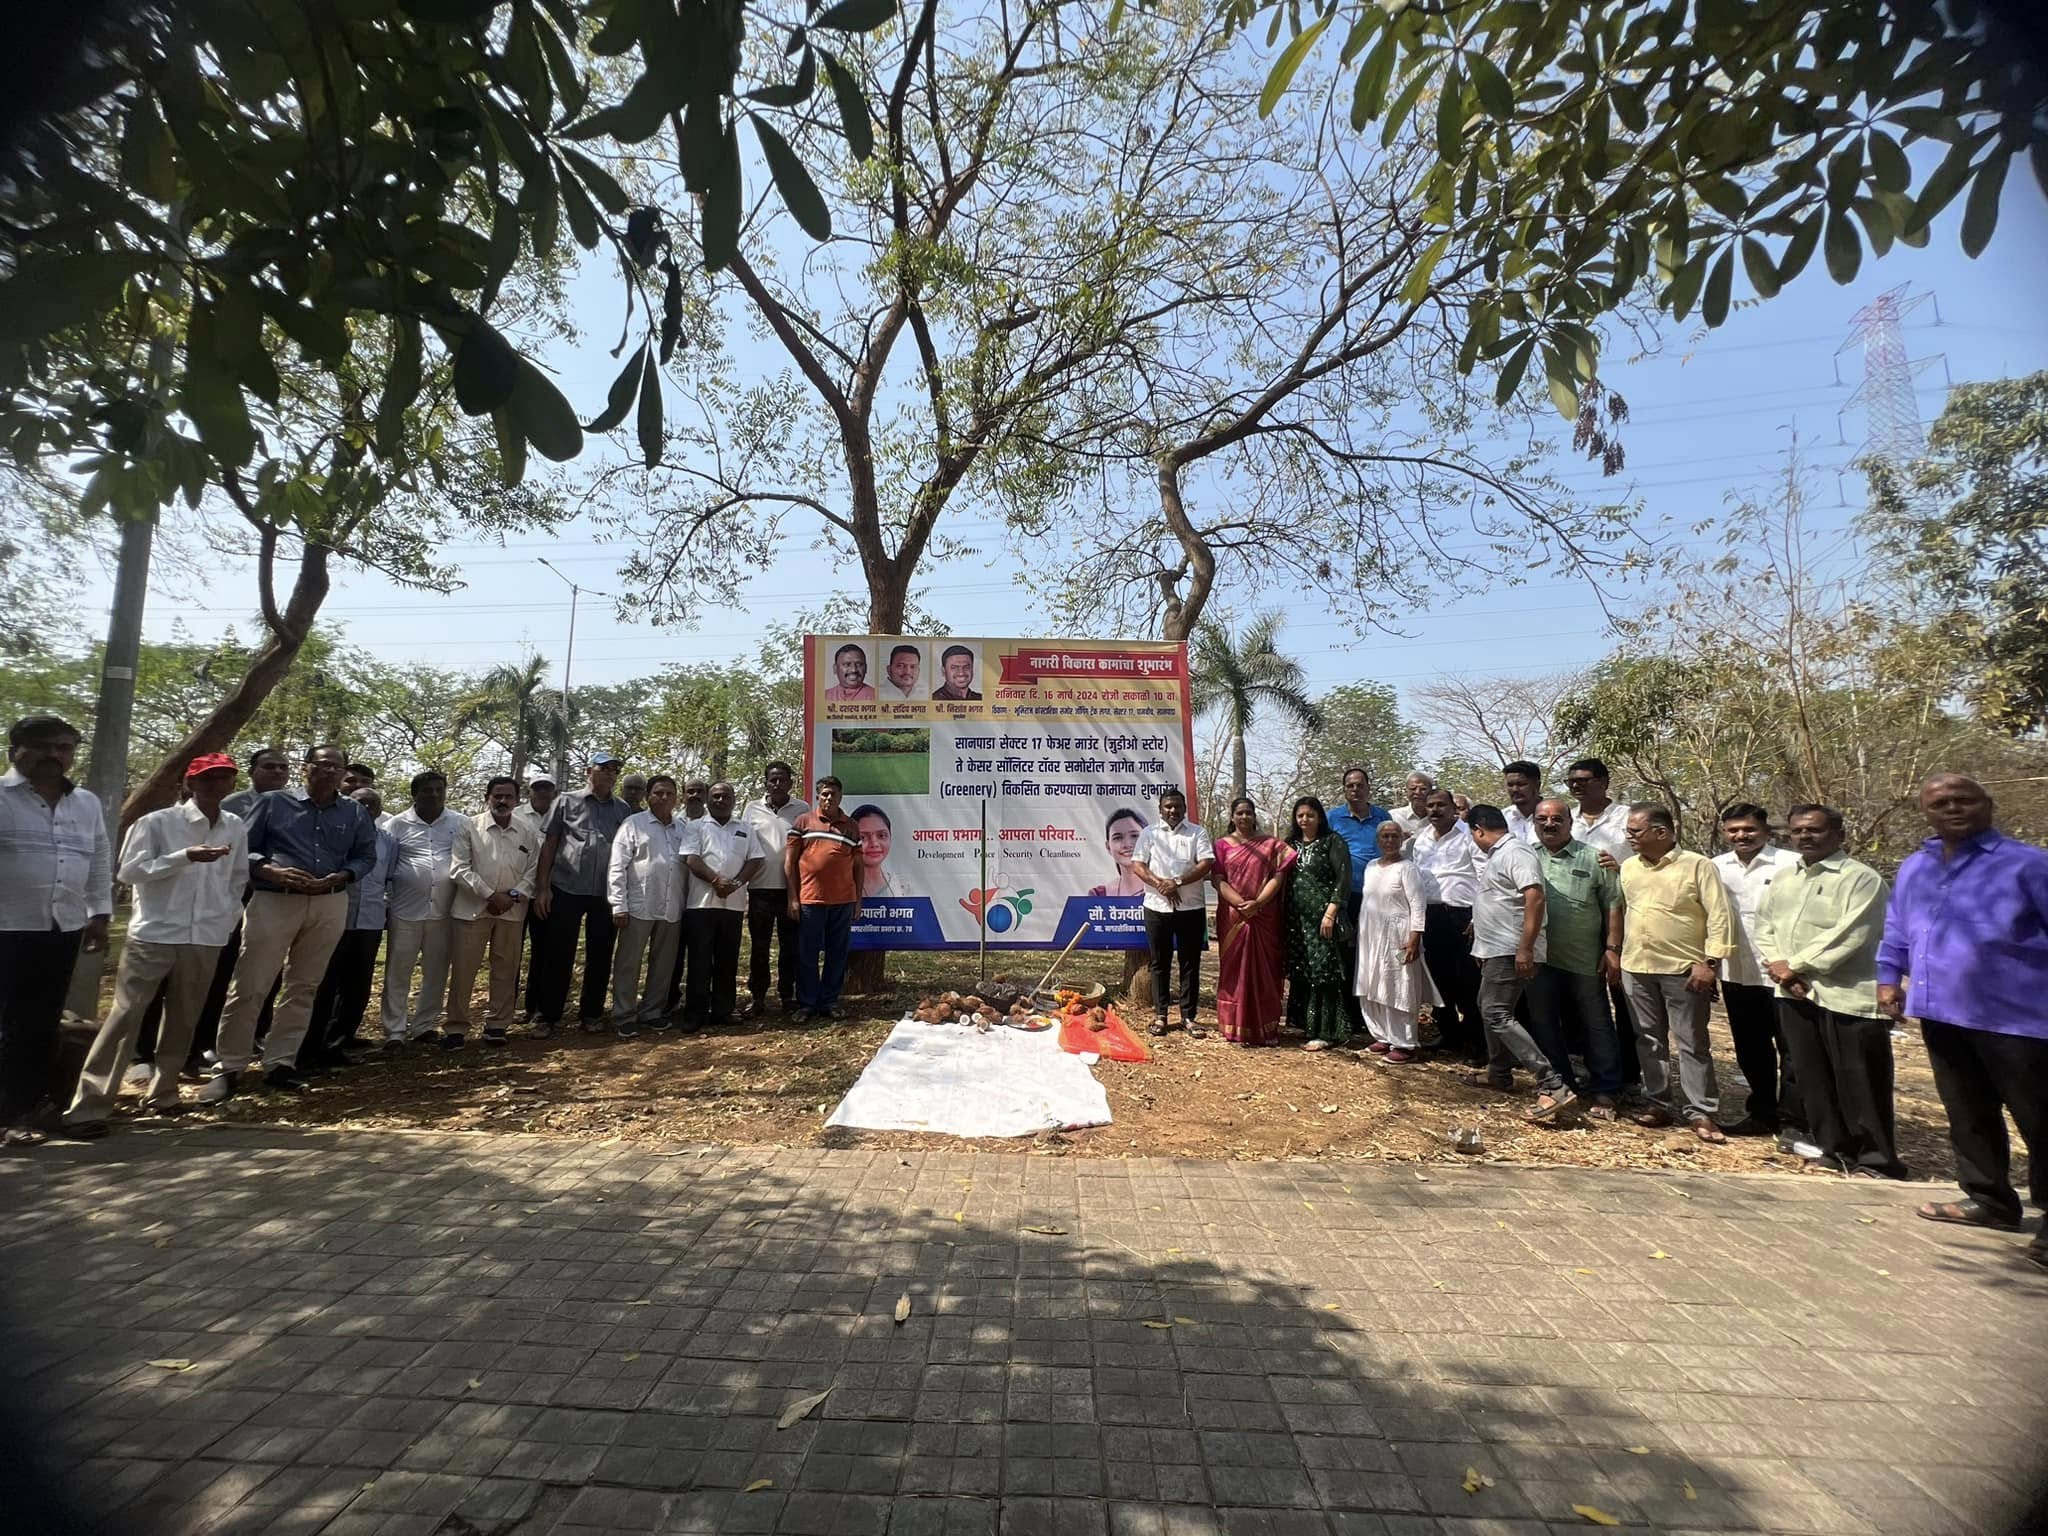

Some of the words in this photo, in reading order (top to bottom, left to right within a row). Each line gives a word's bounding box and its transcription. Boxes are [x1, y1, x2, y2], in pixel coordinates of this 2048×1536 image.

[1030, 655, 1060, 670] नागरी
[1062, 656, 1095, 670] विकास
[1098, 655, 1134, 670] कामांचा
[1138, 655, 1173, 676] शुभारंभ
[996, 688, 1026, 700] शनिवार
[1030, 688, 1040, 700] दि.
[1044, 691, 1053, 700] 16
[1057, 688, 1074, 700] मार्च
[1076, 691, 1098, 700] 2024
[1102, 689, 1119, 701] रोजी
[1122, 689, 1150, 702] सकाळी
[1154, 692, 1163, 701] 10
[861, 704, 876, 712] भगत
[910, 705, 926, 713] भगत
[955, 737, 994, 750] सानपाडा
[1000, 736, 1027, 750] सेक्टर
[1032, 738, 1041, 750] 17
[1046, 736, 1071, 750] फेअर
[1076, 736, 1098, 750] माउंट
[1104, 736, 1138, 753] (जुडीओ
[1142, 736, 1168, 752] स्टोर)
[956, 757, 962, 772] ते
[968, 758, 992, 772] केसर
[997, 757, 1034, 772] सॉलिटर
[1038, 758, 1060, 773] टॉवर
[1065, 758, 1104, 773] समोरील
[1109, 758, 1134, 773] जागेत
[1139, 757, 1164, 774] गार्डन
[940, 782, 997, 798] (Greenery)
[1002, 780, 1040, 796] विकसित
[1044, 783, 1092, 796] करण्याच्या
[1096, 783, 1136, 797] कामाच्या
[912, 828, 948, 842] आपला
[998, 828, 1034, 842] आपला
[918, 848, 965, 860] Development
[1002, 848, 1033, 860] Security
[1040, 848, 1081, 858] Cleanliness
[890, 908, 914, 918] भगत
[1088, 905, 1106, 920] सौ.
[1108, 905, 1144, 920] वैजयंती
